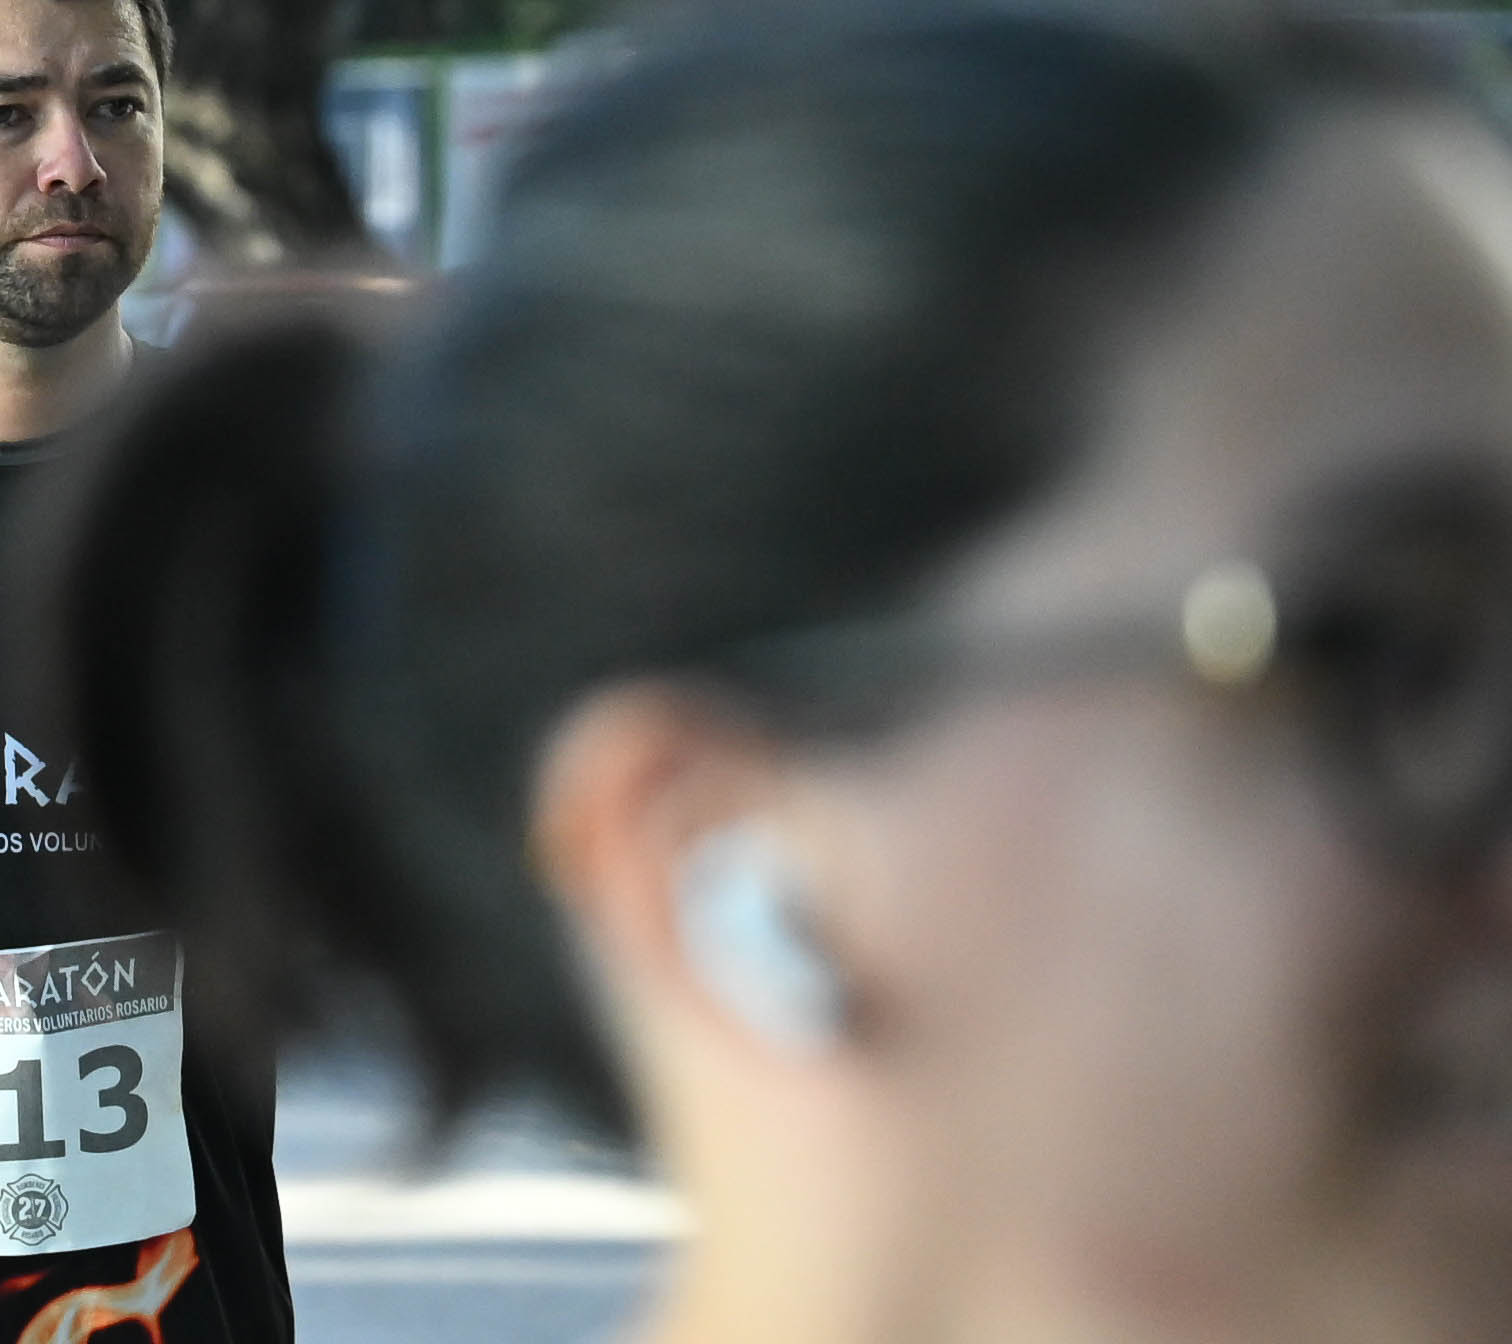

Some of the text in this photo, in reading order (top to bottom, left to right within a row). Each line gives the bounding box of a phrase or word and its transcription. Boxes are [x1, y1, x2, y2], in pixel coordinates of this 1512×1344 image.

[33, 1003, 114, 1035] VOLUNTARIOS
[115, 994, 169, 1018] ROSARIO
[18, 1196, 46, 1221] 27
